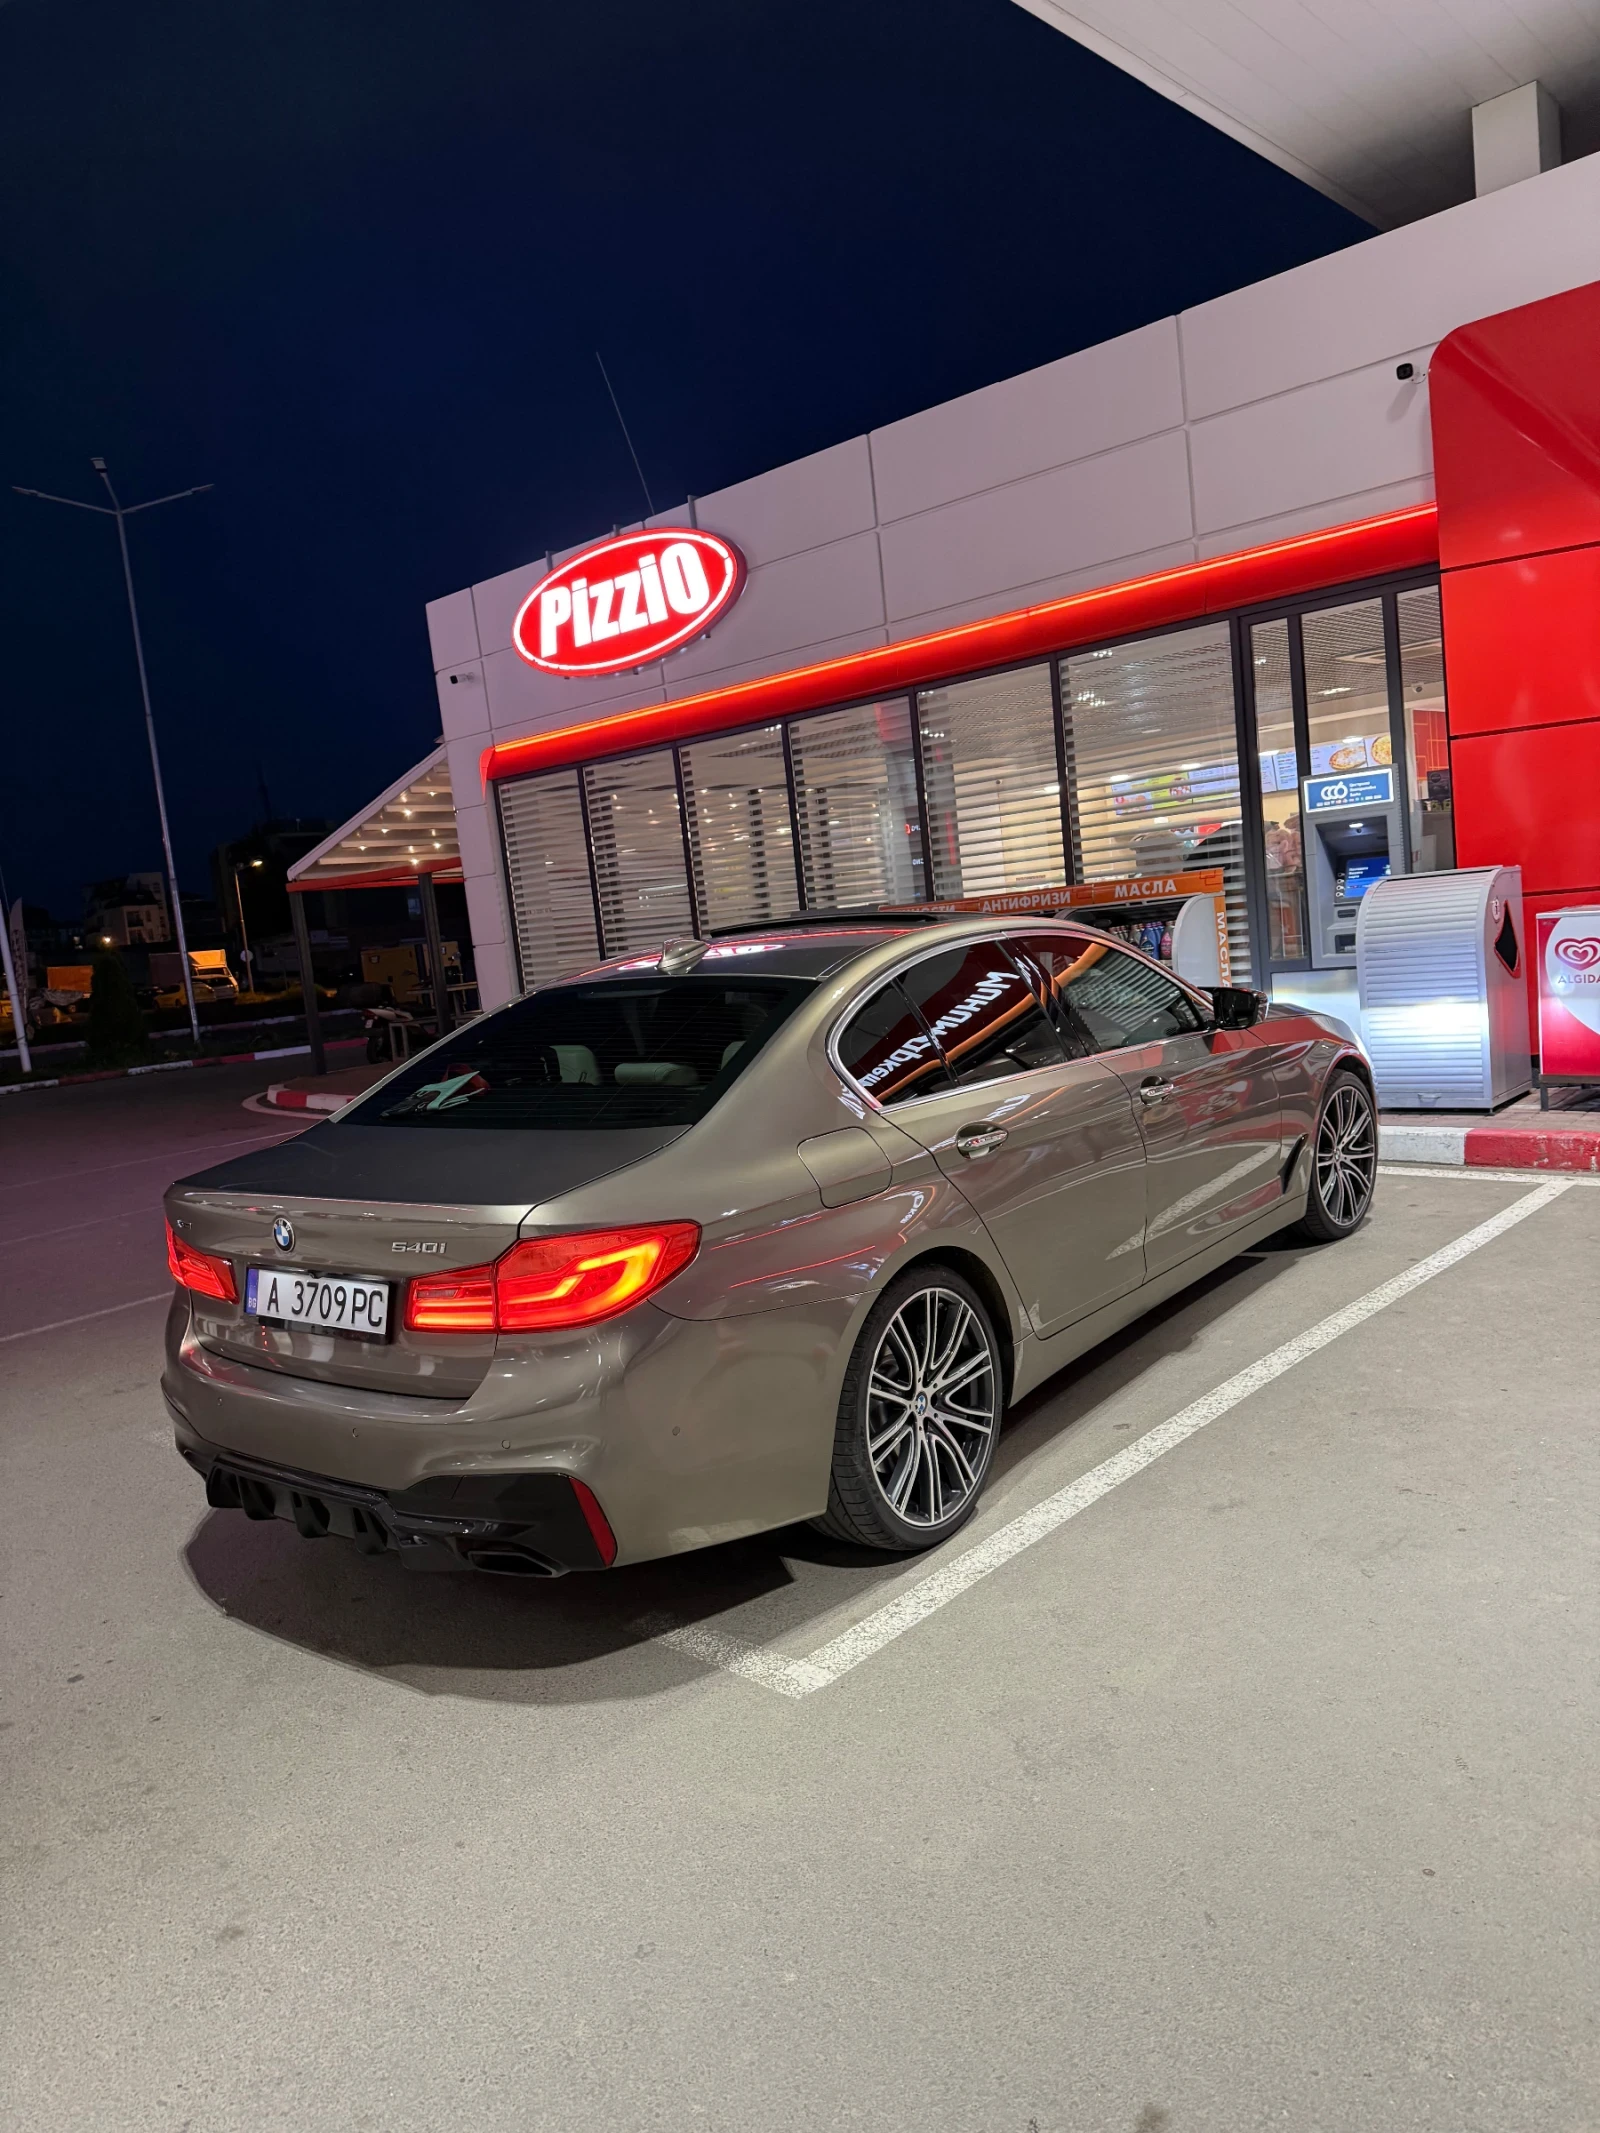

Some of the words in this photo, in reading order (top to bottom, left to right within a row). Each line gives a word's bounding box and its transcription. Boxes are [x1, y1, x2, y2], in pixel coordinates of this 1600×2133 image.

[1115, 880, 1177, 898] МАСЛА
[983, 891, 1071, 912] АНТИФРИЗИ
[391, 1242, 447, 1253] 540i
[248, 1297, 257, 1308] BG
[291, 1280, 347, 1322] 3709
